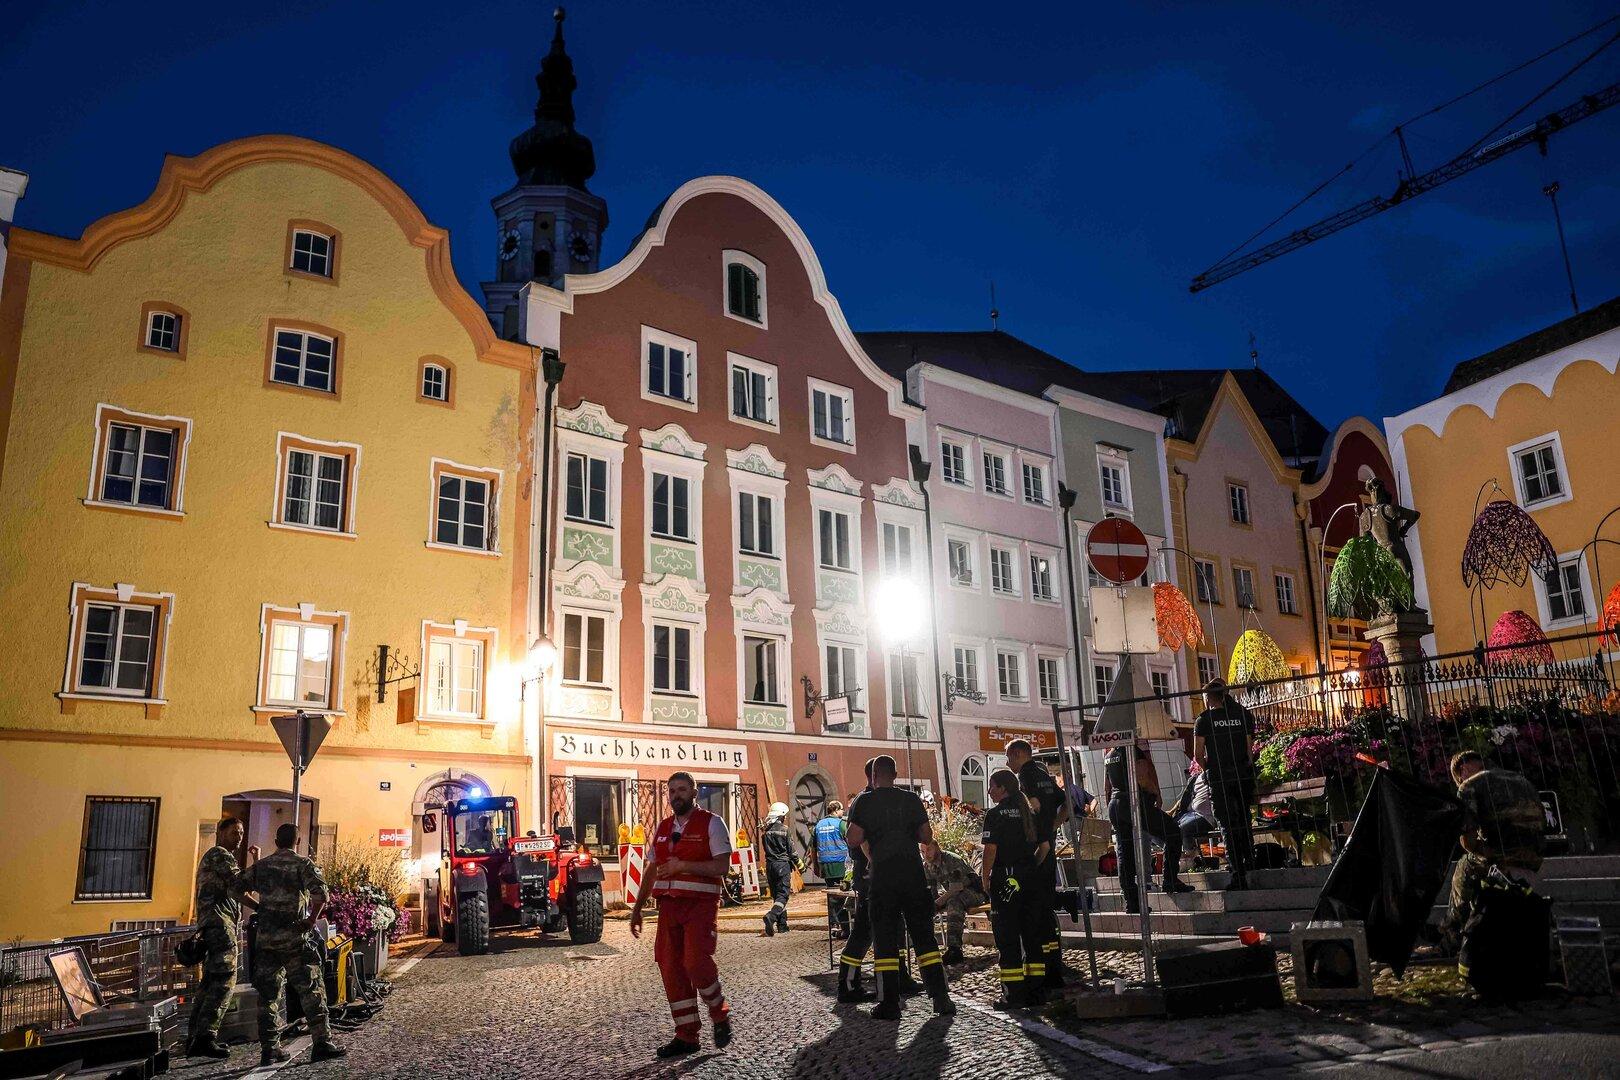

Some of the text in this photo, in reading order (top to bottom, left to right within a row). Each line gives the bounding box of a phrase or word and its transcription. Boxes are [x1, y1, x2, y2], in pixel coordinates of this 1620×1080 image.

[1213, 719, 1242, 727] POLIZEI
[989, 730, 1038, 743] Street
[560, 735, 743, 768] Buchhandlung
